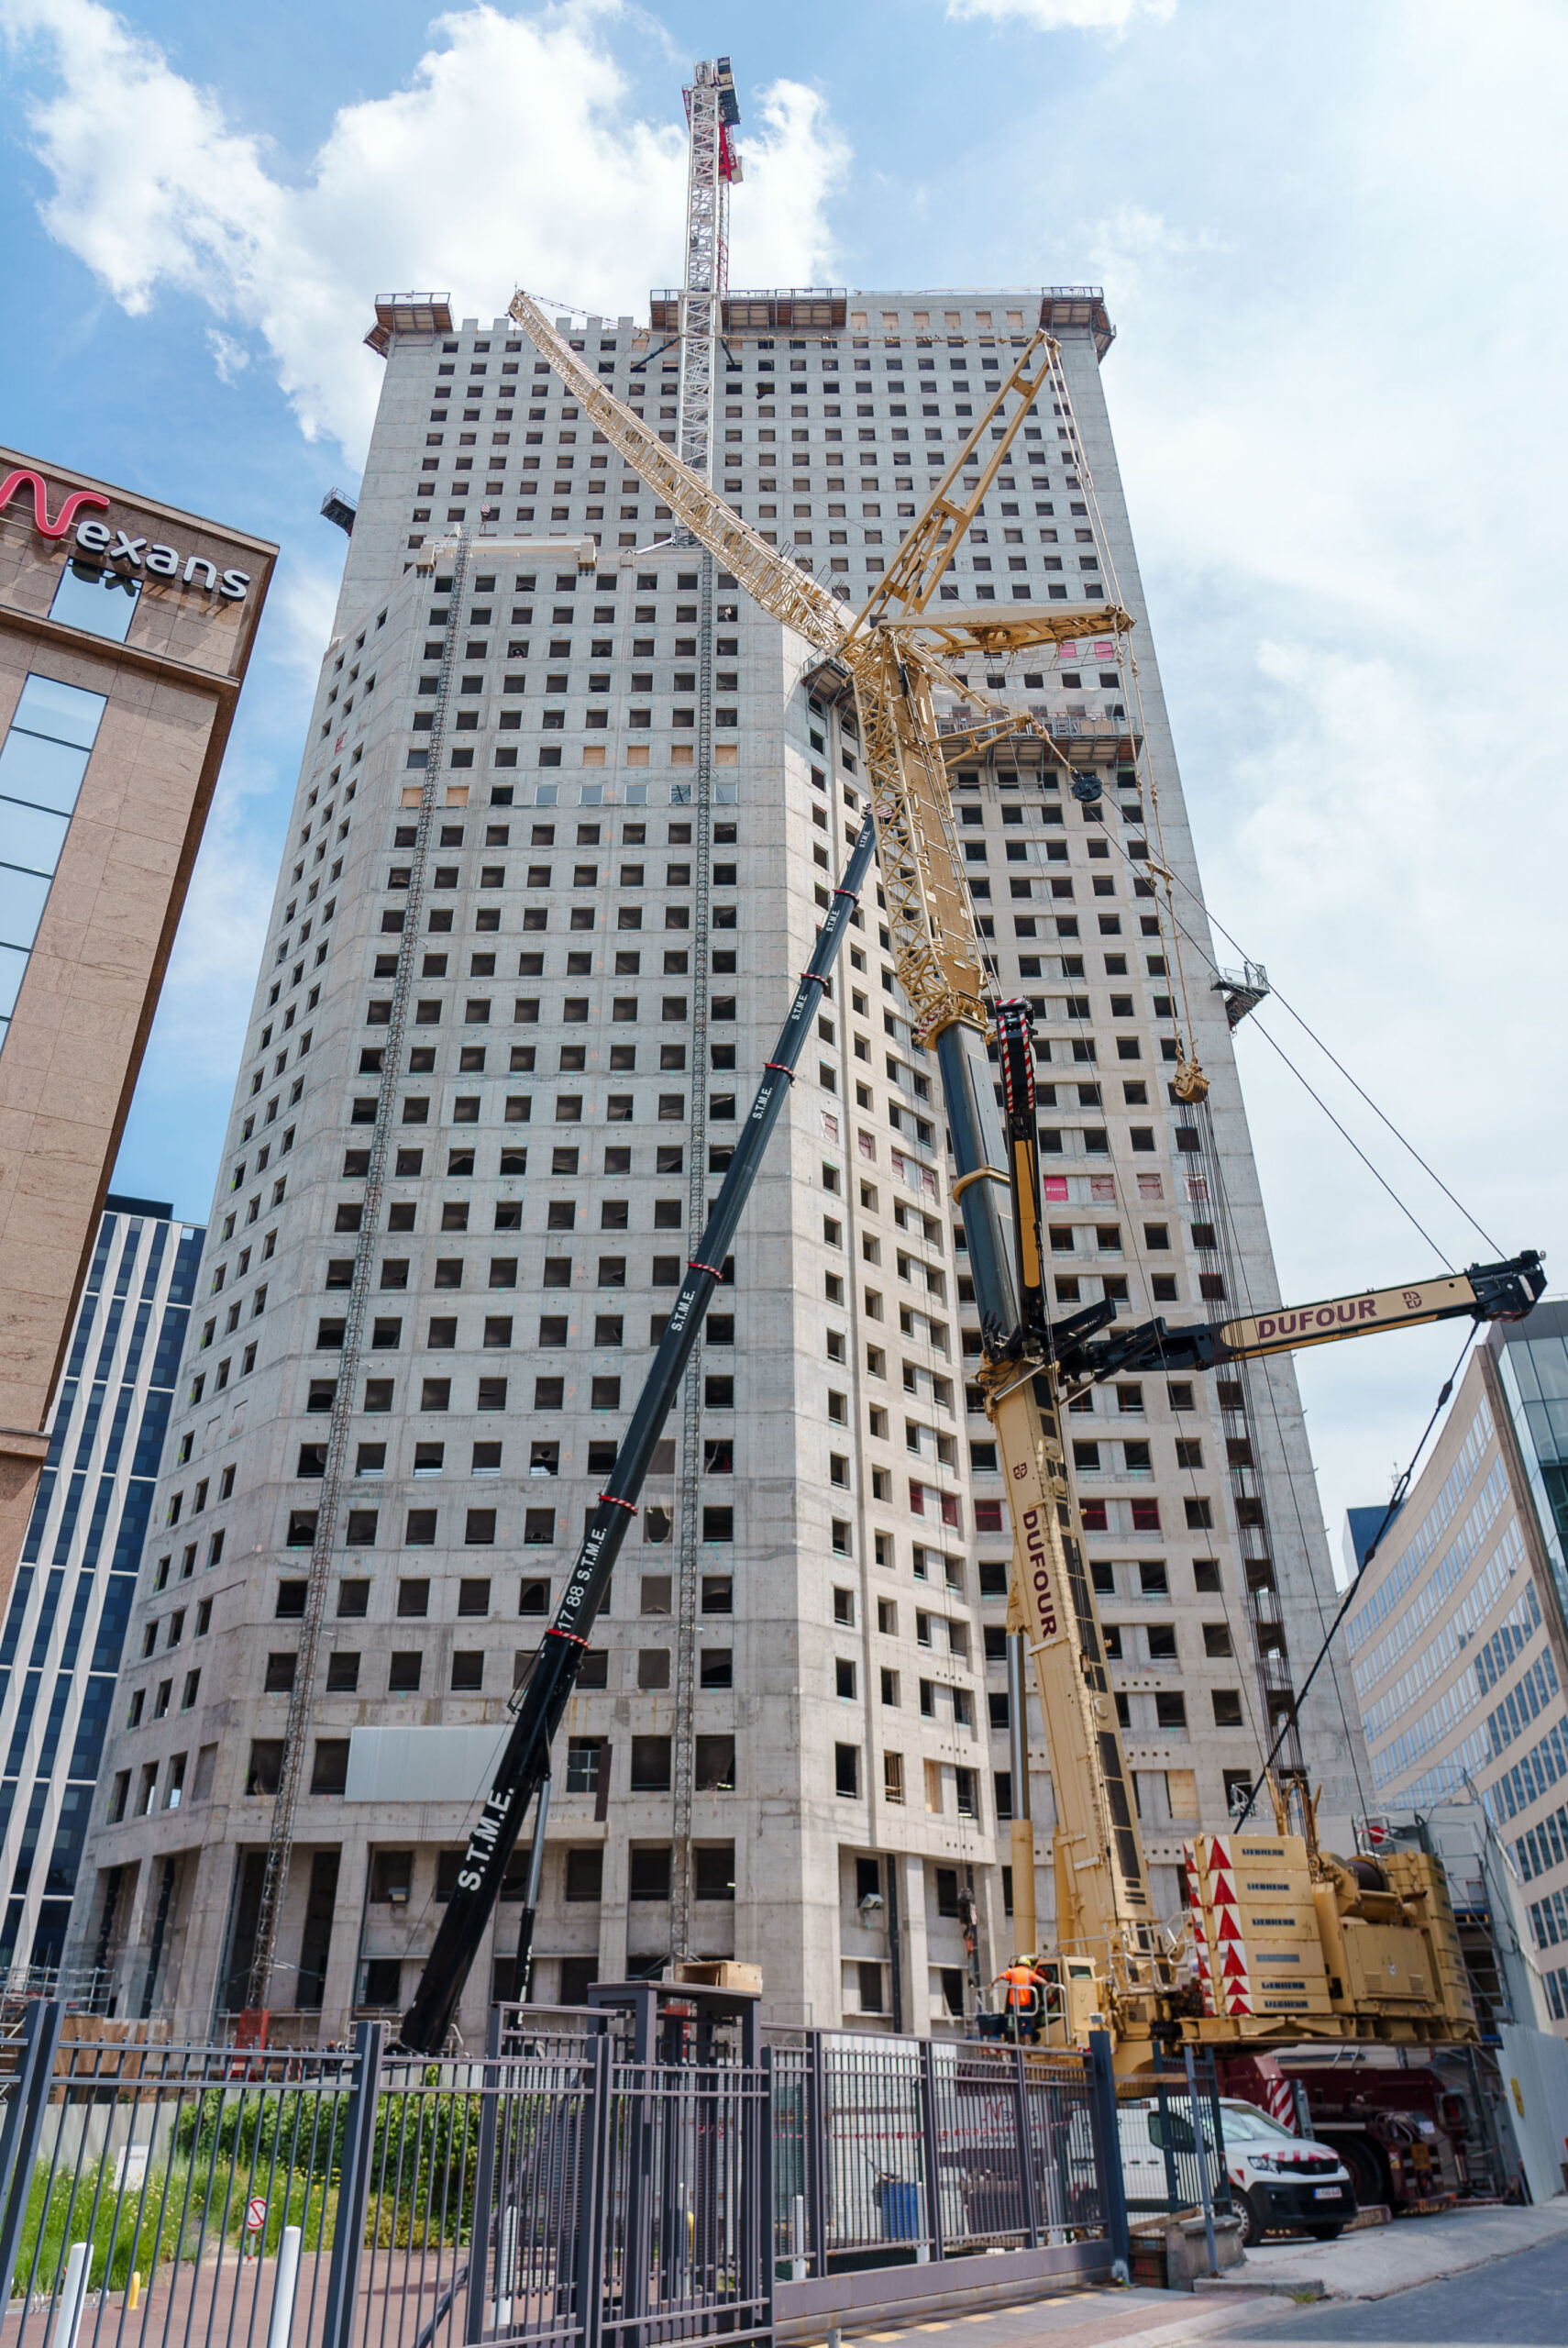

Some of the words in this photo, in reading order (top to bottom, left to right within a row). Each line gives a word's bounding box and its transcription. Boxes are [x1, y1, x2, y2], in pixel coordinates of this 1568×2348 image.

[791, 993, 808, 1020] S.T.M.E.
[752, 1087, 773, 1120] S.T.M.E.
[670, 1290, 696, 1331] S.T.M.E.
[1258, 1299, 1377, 1339] DUFOUR
[558, 1610, 574, 1630] 17
[566, 1586, 584, 1607] 88
[576, 1527, 607, 1581] S.T.M.E.
[1022, 1509, 1057, 1638] DUFOUR
[458, 1788, 514, 1891] S.T.M.E.
